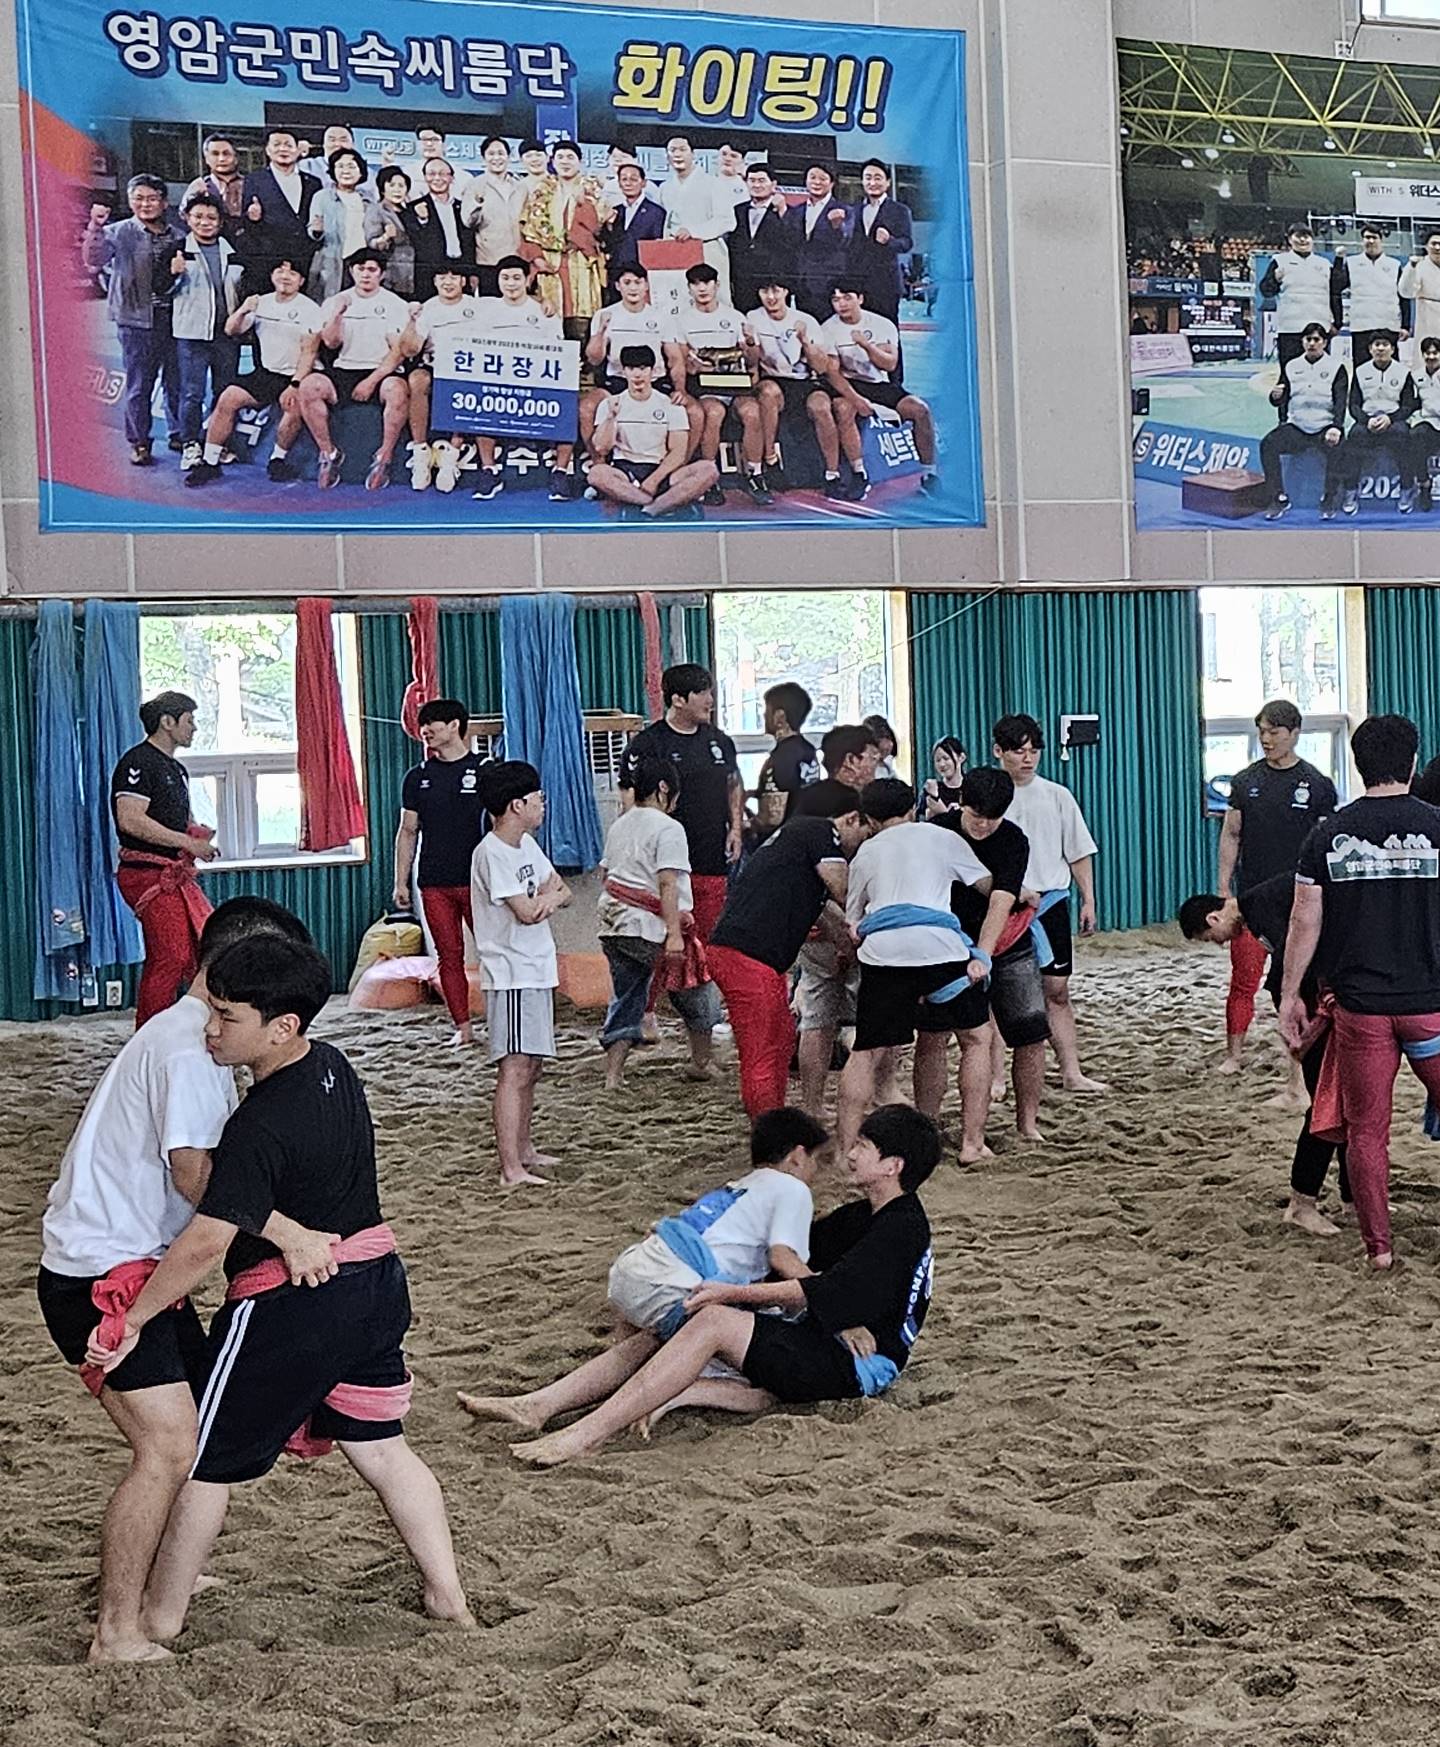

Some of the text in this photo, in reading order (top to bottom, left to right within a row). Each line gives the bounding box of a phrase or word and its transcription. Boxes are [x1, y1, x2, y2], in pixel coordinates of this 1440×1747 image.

[107, 14, 885, 125] 영암군민속씨름단 화이팅!!
[454, 350, 562, 381] 한라장사
[452, 392, 561, 418] 30,000,000
[1151, 433, 1249, 475] 위더스제약
